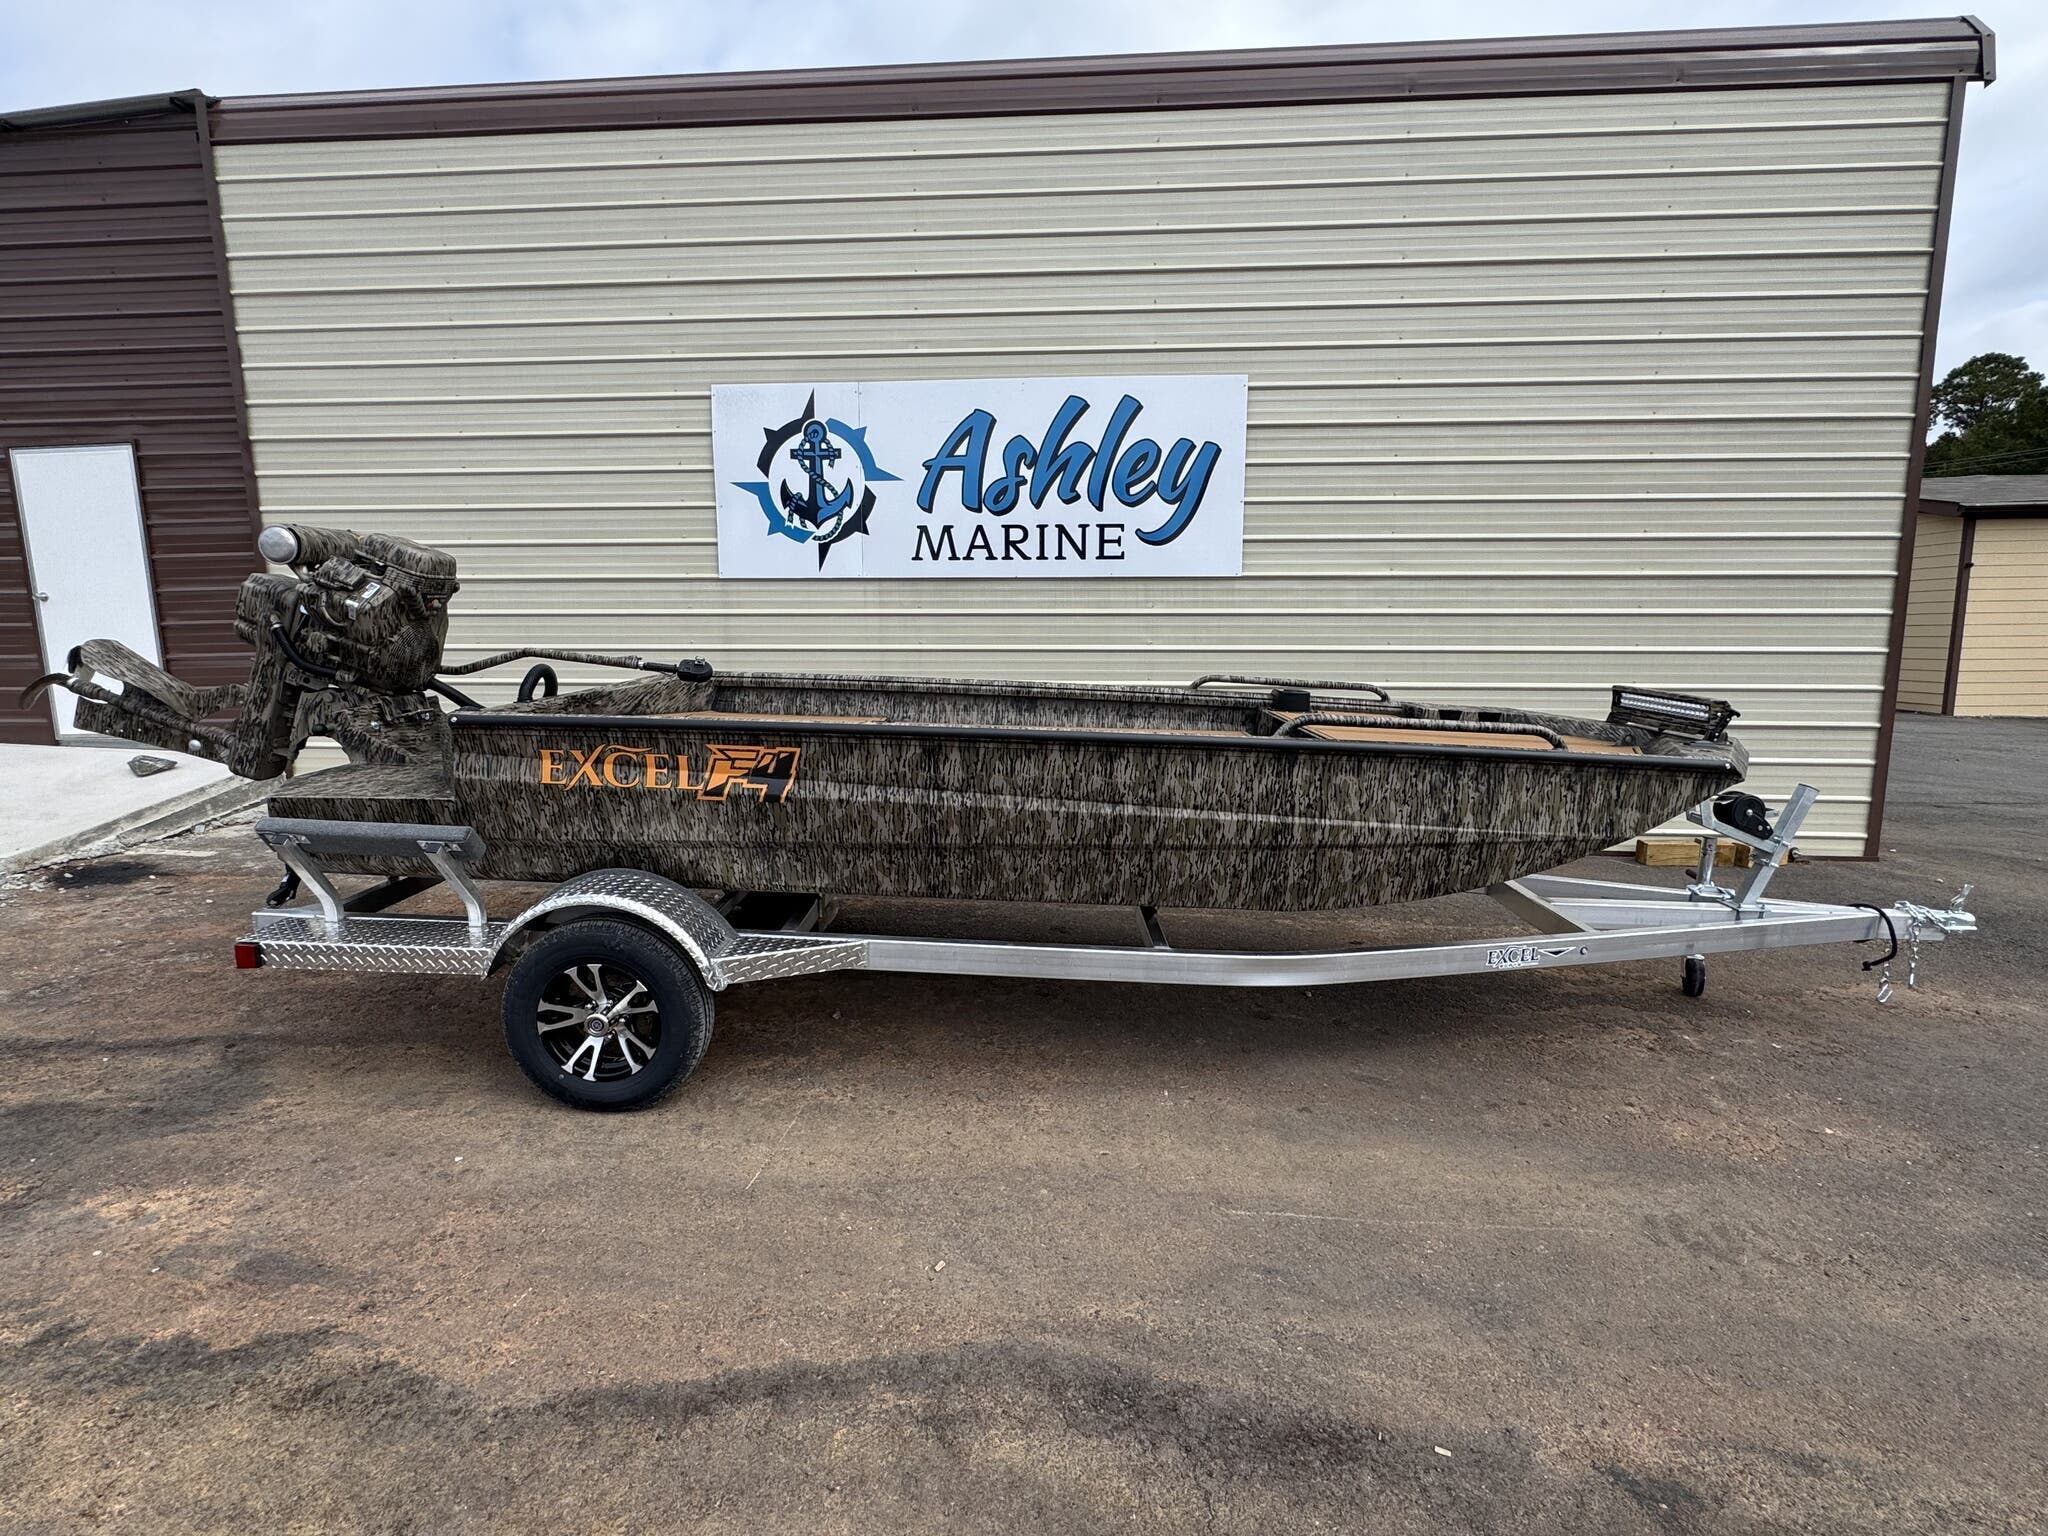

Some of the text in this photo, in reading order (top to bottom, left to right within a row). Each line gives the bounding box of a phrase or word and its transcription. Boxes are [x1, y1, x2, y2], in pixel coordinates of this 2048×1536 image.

[916, 394, 1222, 547] Ashley
[911, 523, 1126, 561] MARINE
[539, 744, 704, 791] EXCEL
[1486, 945, 1540, 967] EXCEL
